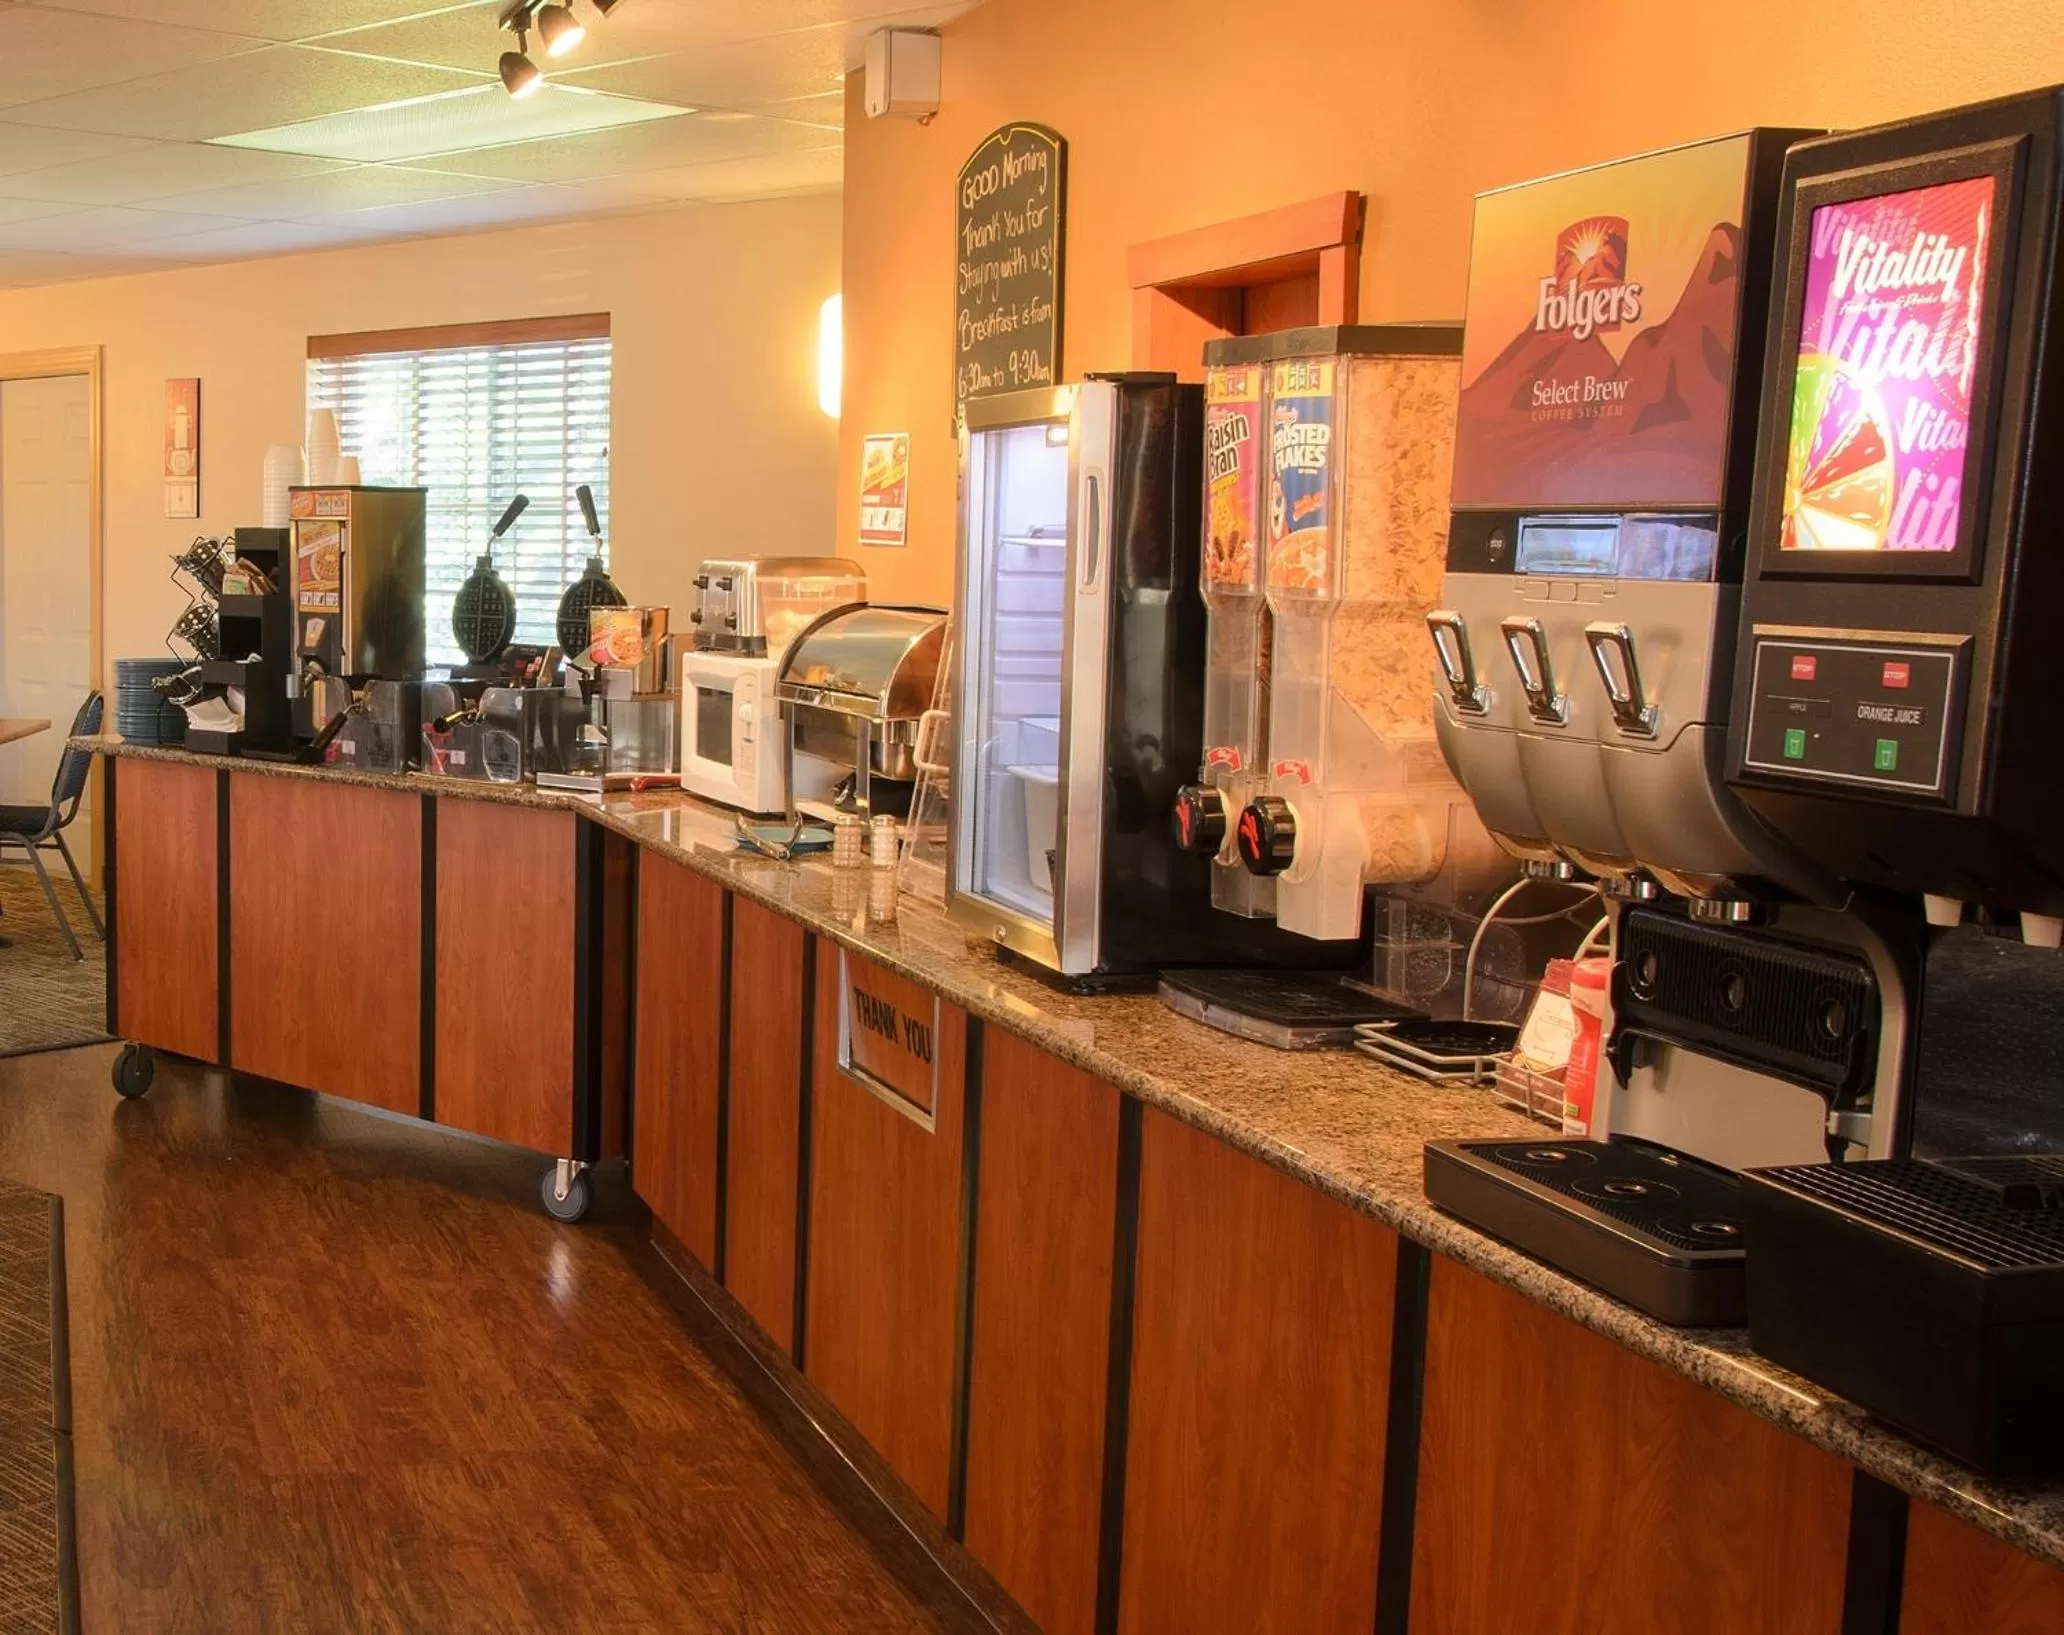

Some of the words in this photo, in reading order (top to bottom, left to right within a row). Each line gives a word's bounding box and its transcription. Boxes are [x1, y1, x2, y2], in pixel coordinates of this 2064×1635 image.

[962, 164, 999, 210] GOOD
[1002, 144, 1047, 196] Morning
[962, 211, 1001, 257] Thank
[1003, 209, 1024, 238] You
[1026, 198, 1049, 232] for
[959, 258, 1000, 305] Staying
[1000, 246, 1028, 278] with
[1031, 239, 1052, 277] us!
[1833, 228, 1967, 302] Vitality
[959, 303, 1019, 352] Breakfast
[1022, 303, 1030, 326] is
[1030, 296, 1052, 324] from
[1535, 276, 1643, 342] Folgers
[992, 367, 1005, 387] to
[1532, 379, 1579, 407] Select
[1583, 375, 1628, 402] Brew
[1532, 408, 1574, 422] COFFEE
[1577, 404, 1623, 420] SYSTEM
[1857, 705, 1895, 723] ORANGE
[1894, 708, 1921, 725] JUICE
[854, 986, 898, 1045] THANK
[902, 1013, 932, 1065] YOU
